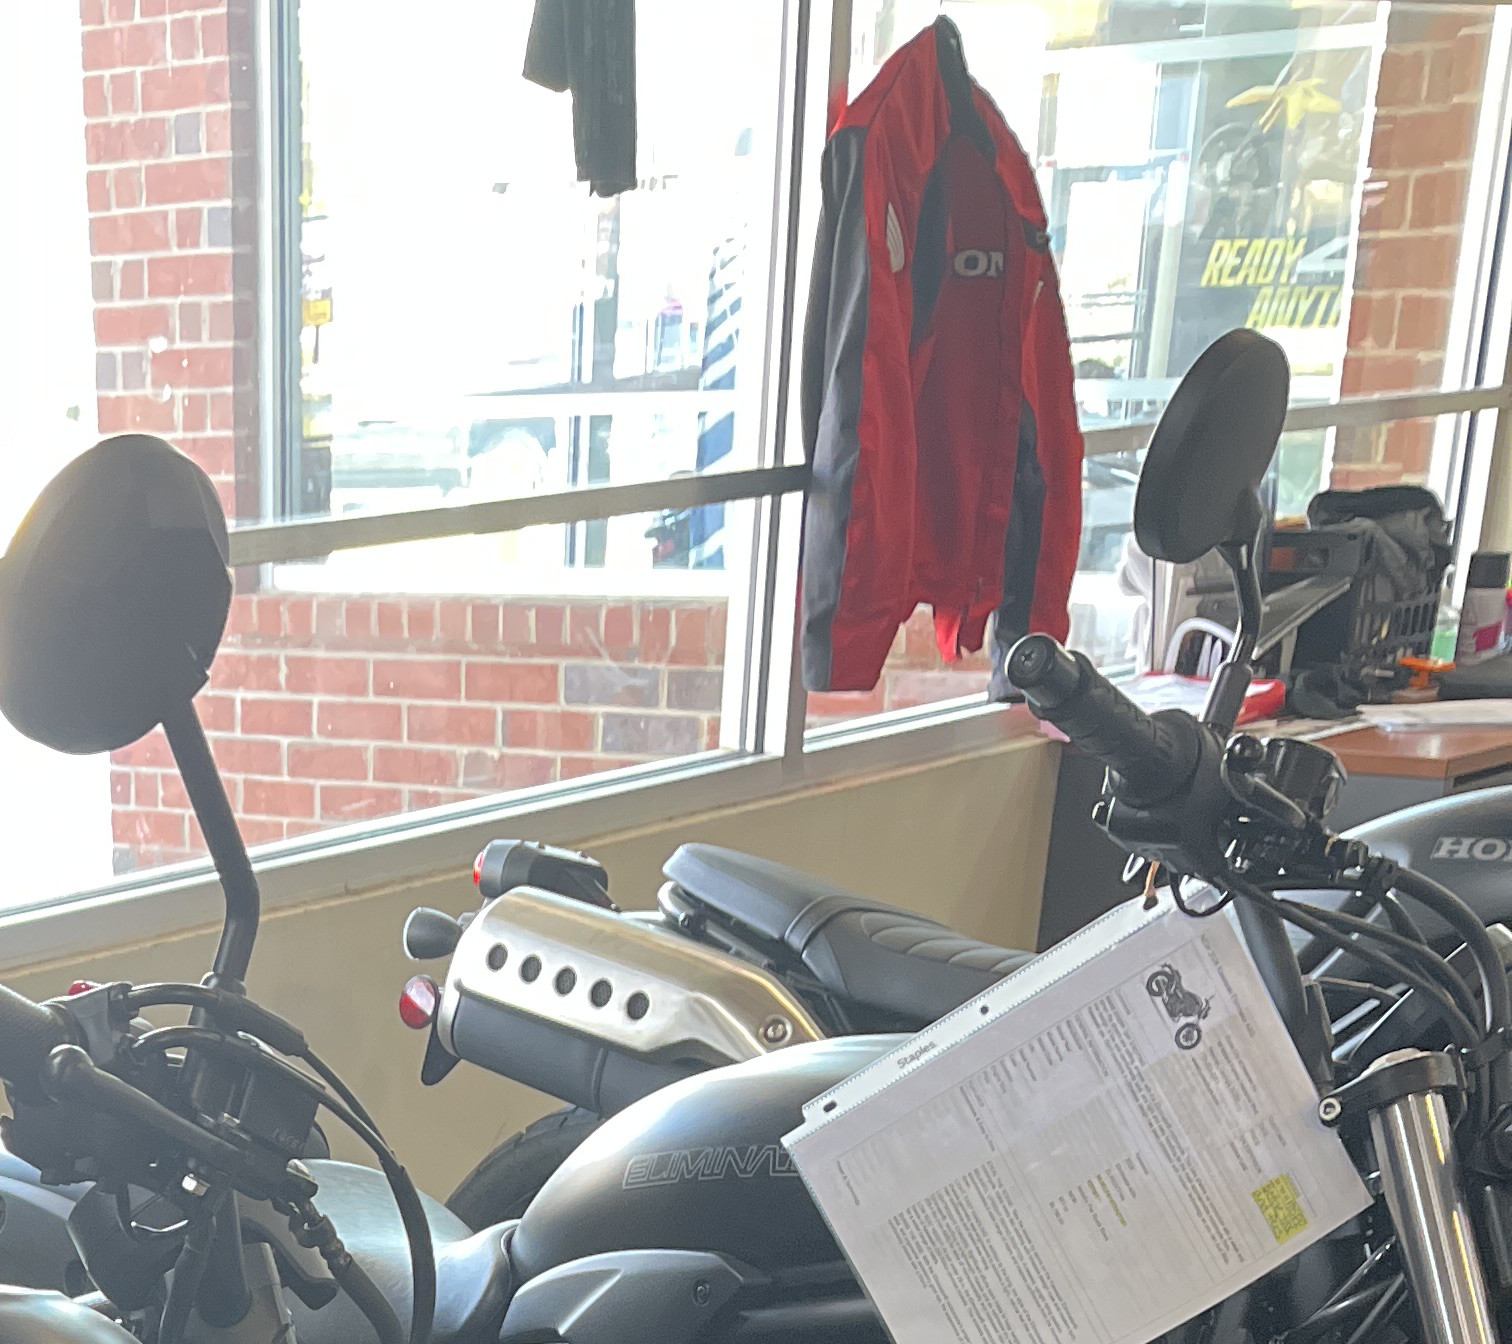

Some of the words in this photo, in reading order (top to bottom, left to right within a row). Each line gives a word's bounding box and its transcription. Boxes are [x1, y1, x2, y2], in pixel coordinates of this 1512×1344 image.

[1201, 237, 1308, 288] READY
[1430, 836, 1512, 862] HO
[897, 1041, 936, 1069] Staples
[622, 1145, 799, 1190] ELIMINA
